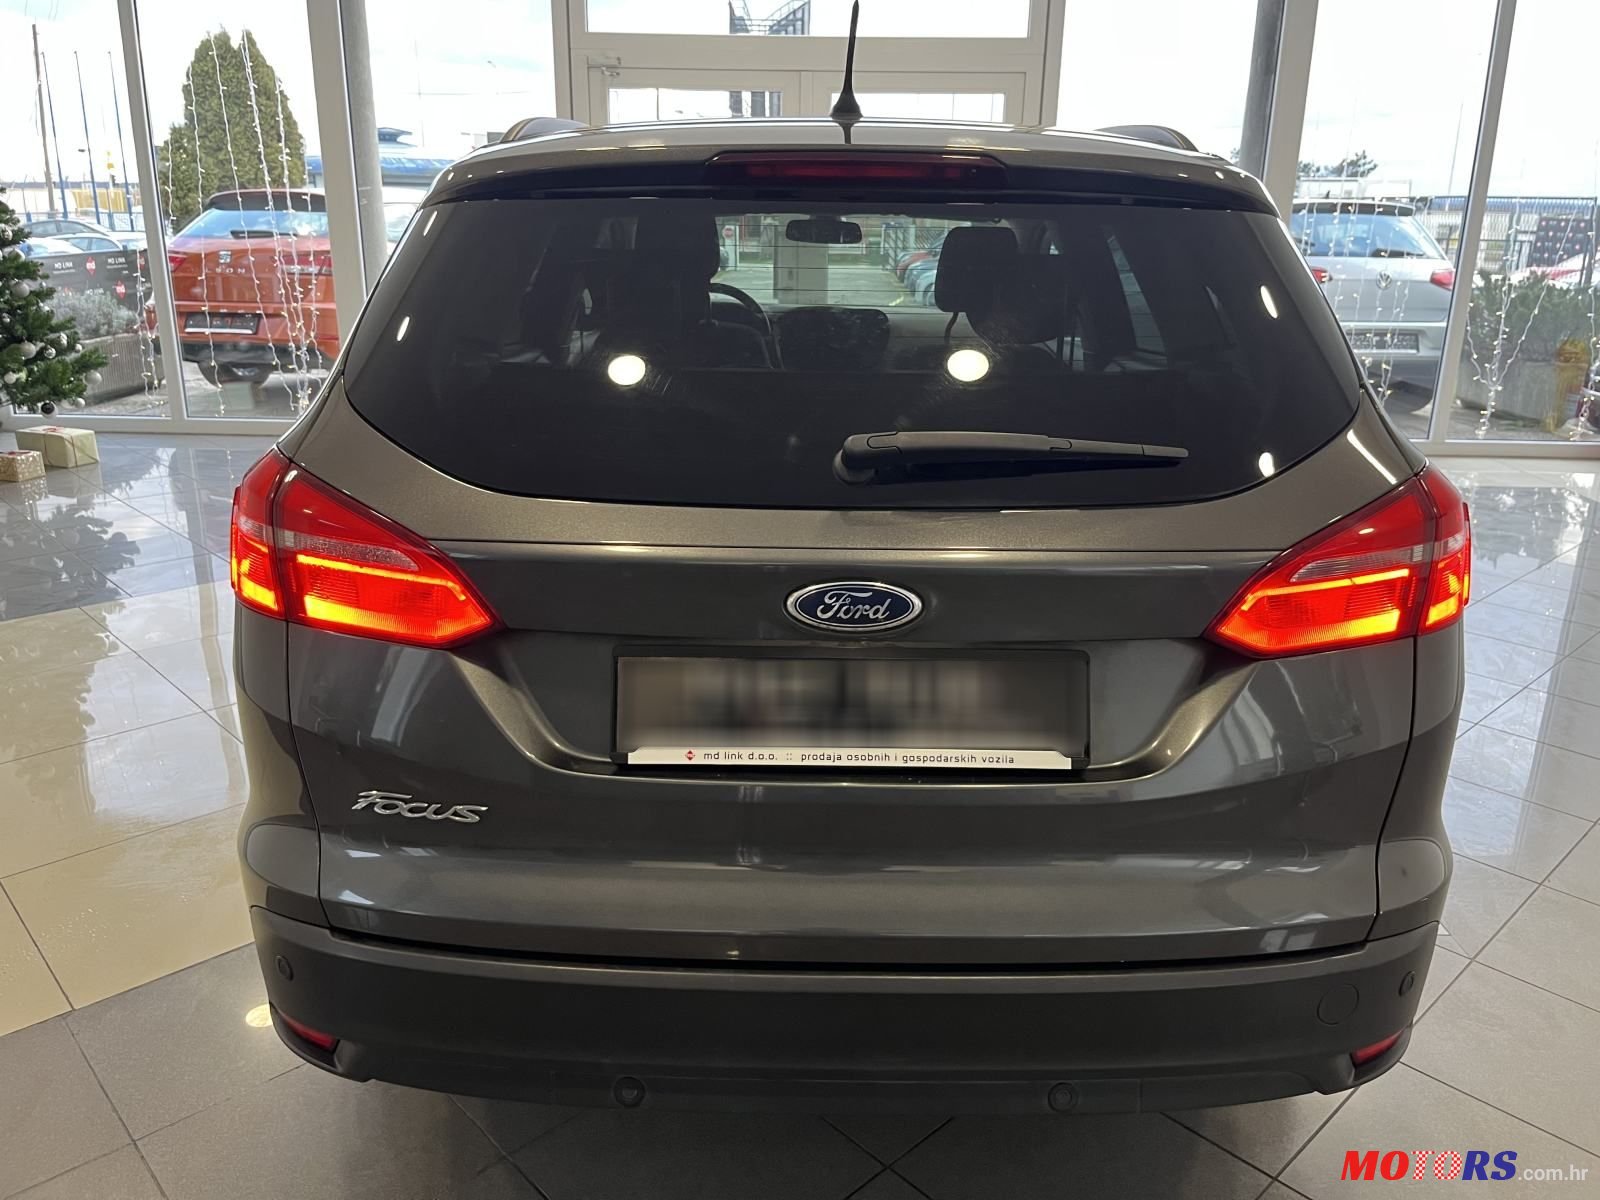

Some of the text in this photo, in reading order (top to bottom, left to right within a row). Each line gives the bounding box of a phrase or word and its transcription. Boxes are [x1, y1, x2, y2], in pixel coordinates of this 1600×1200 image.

[816, 590, 892, 620] Ford
[703, 751, 720, 760] md
[724, 751, 743, 760] link
[748, 751, 778, 761] d.o.o.
[800, 751, 842, 763] prodaja
[846, 752, 890, 762] osobnih
[894, 752, 898, 762] i
[902, 753, 977, 764] gospodarskih
[981, 754, 1015, 764] vozila
